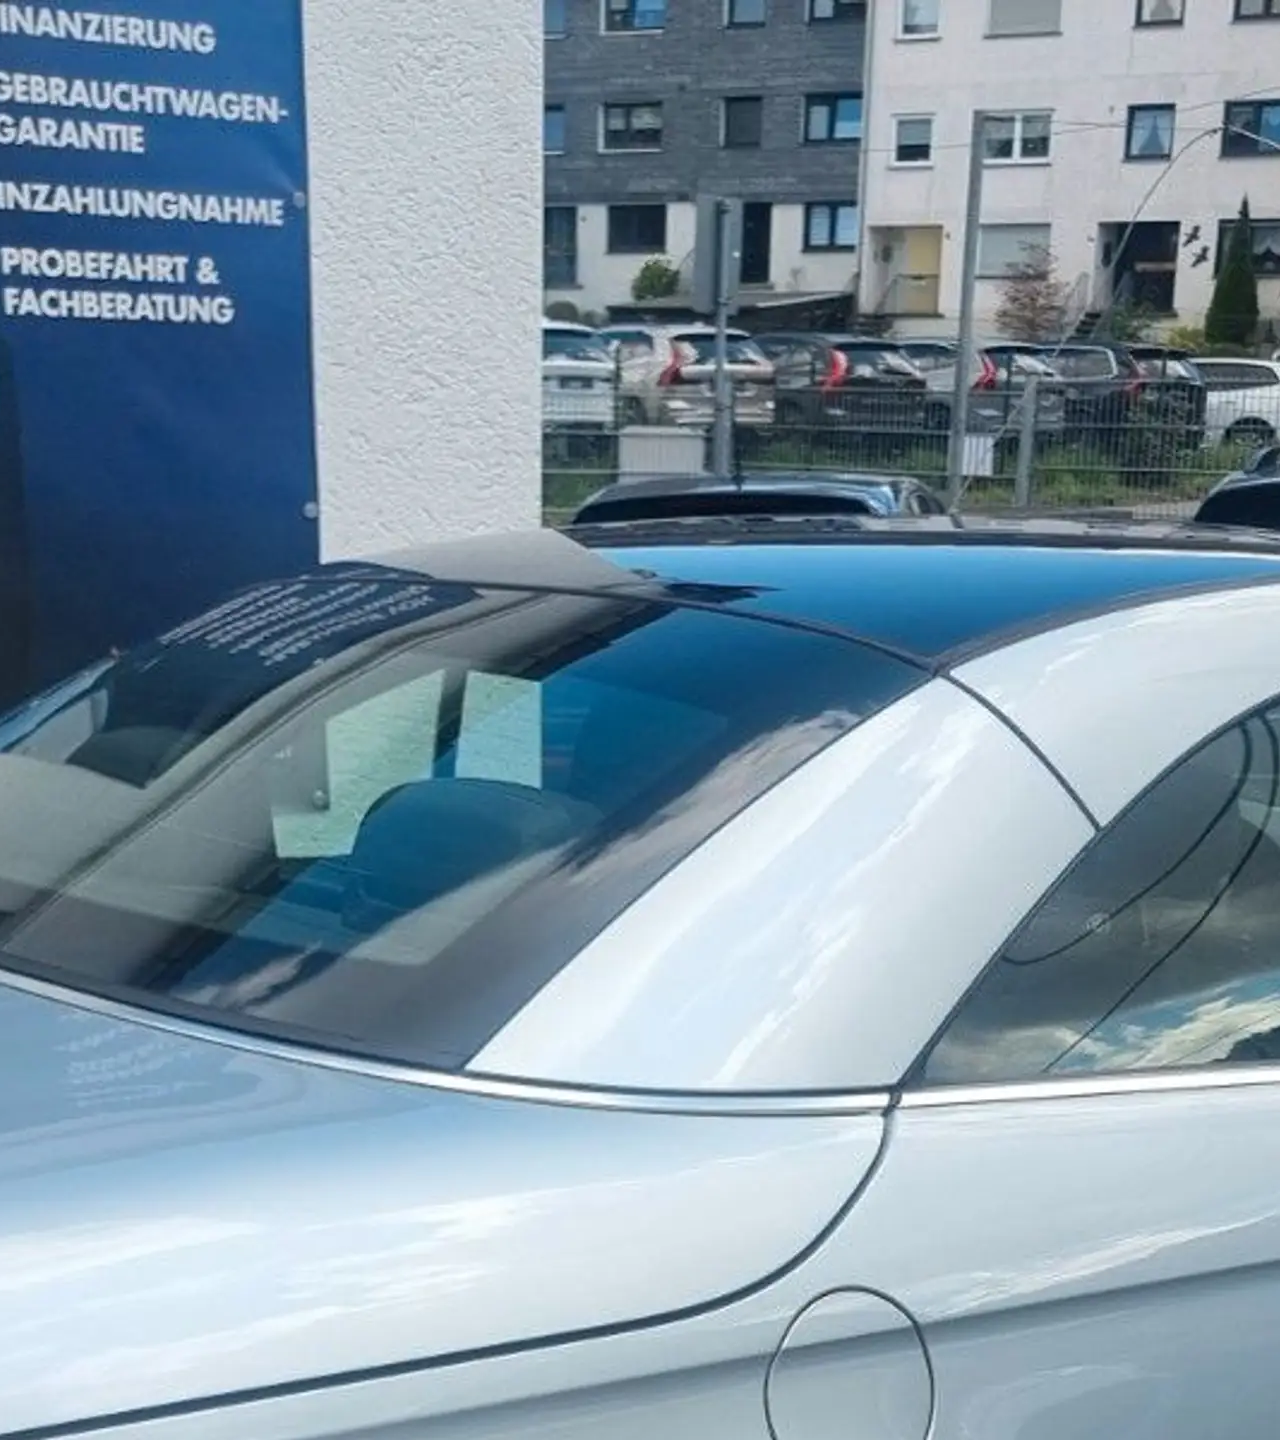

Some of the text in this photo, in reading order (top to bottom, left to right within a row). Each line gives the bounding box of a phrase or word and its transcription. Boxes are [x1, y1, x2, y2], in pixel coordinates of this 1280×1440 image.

[0, 247, 221, 285] PROBEFAHRT &
[3, 288, 236, 324] FACHBERATUNG
